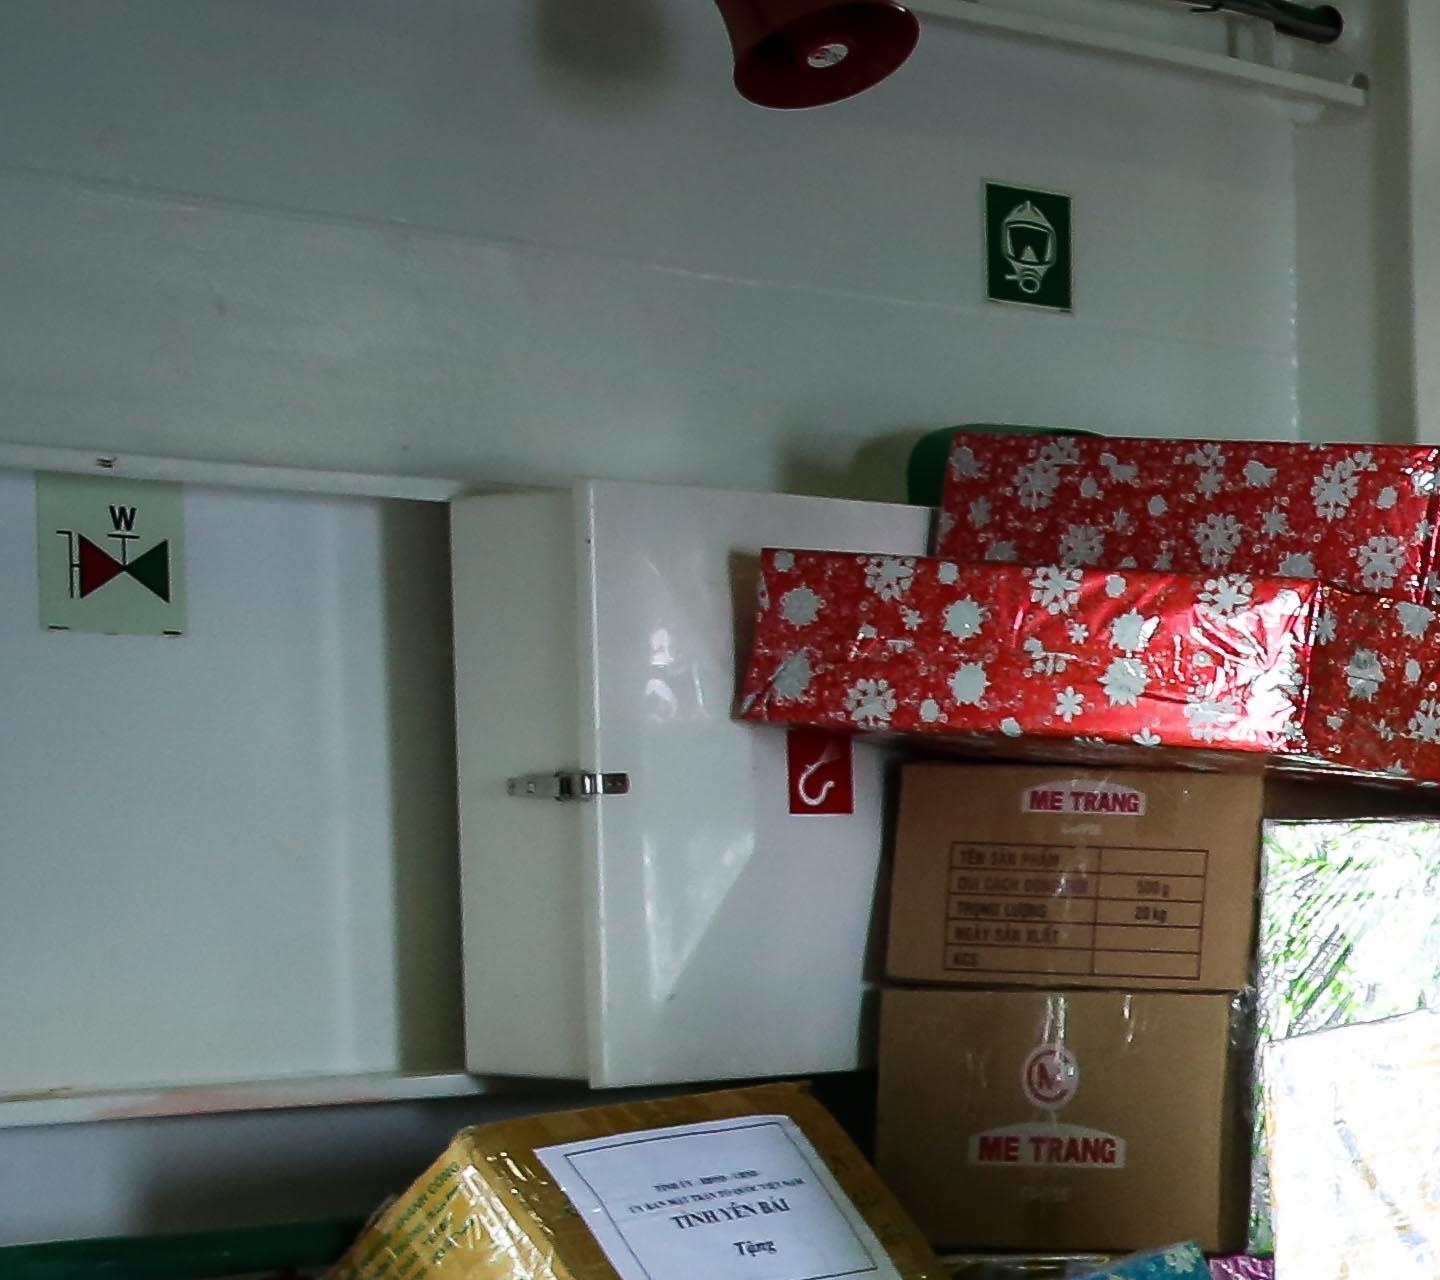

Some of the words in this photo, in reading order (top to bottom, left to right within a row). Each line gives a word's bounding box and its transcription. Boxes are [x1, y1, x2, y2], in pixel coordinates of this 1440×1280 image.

[109, 504, 137, 531] W
[1029, 790, 1063, 811] ME
[1070, 791, 1142, 813] TRANG
[979, 1136, 1019, 1161] ME
[1029, 1136, 1117, 1163] TRANG
[733, 1240, 777, 1257] Tặng
